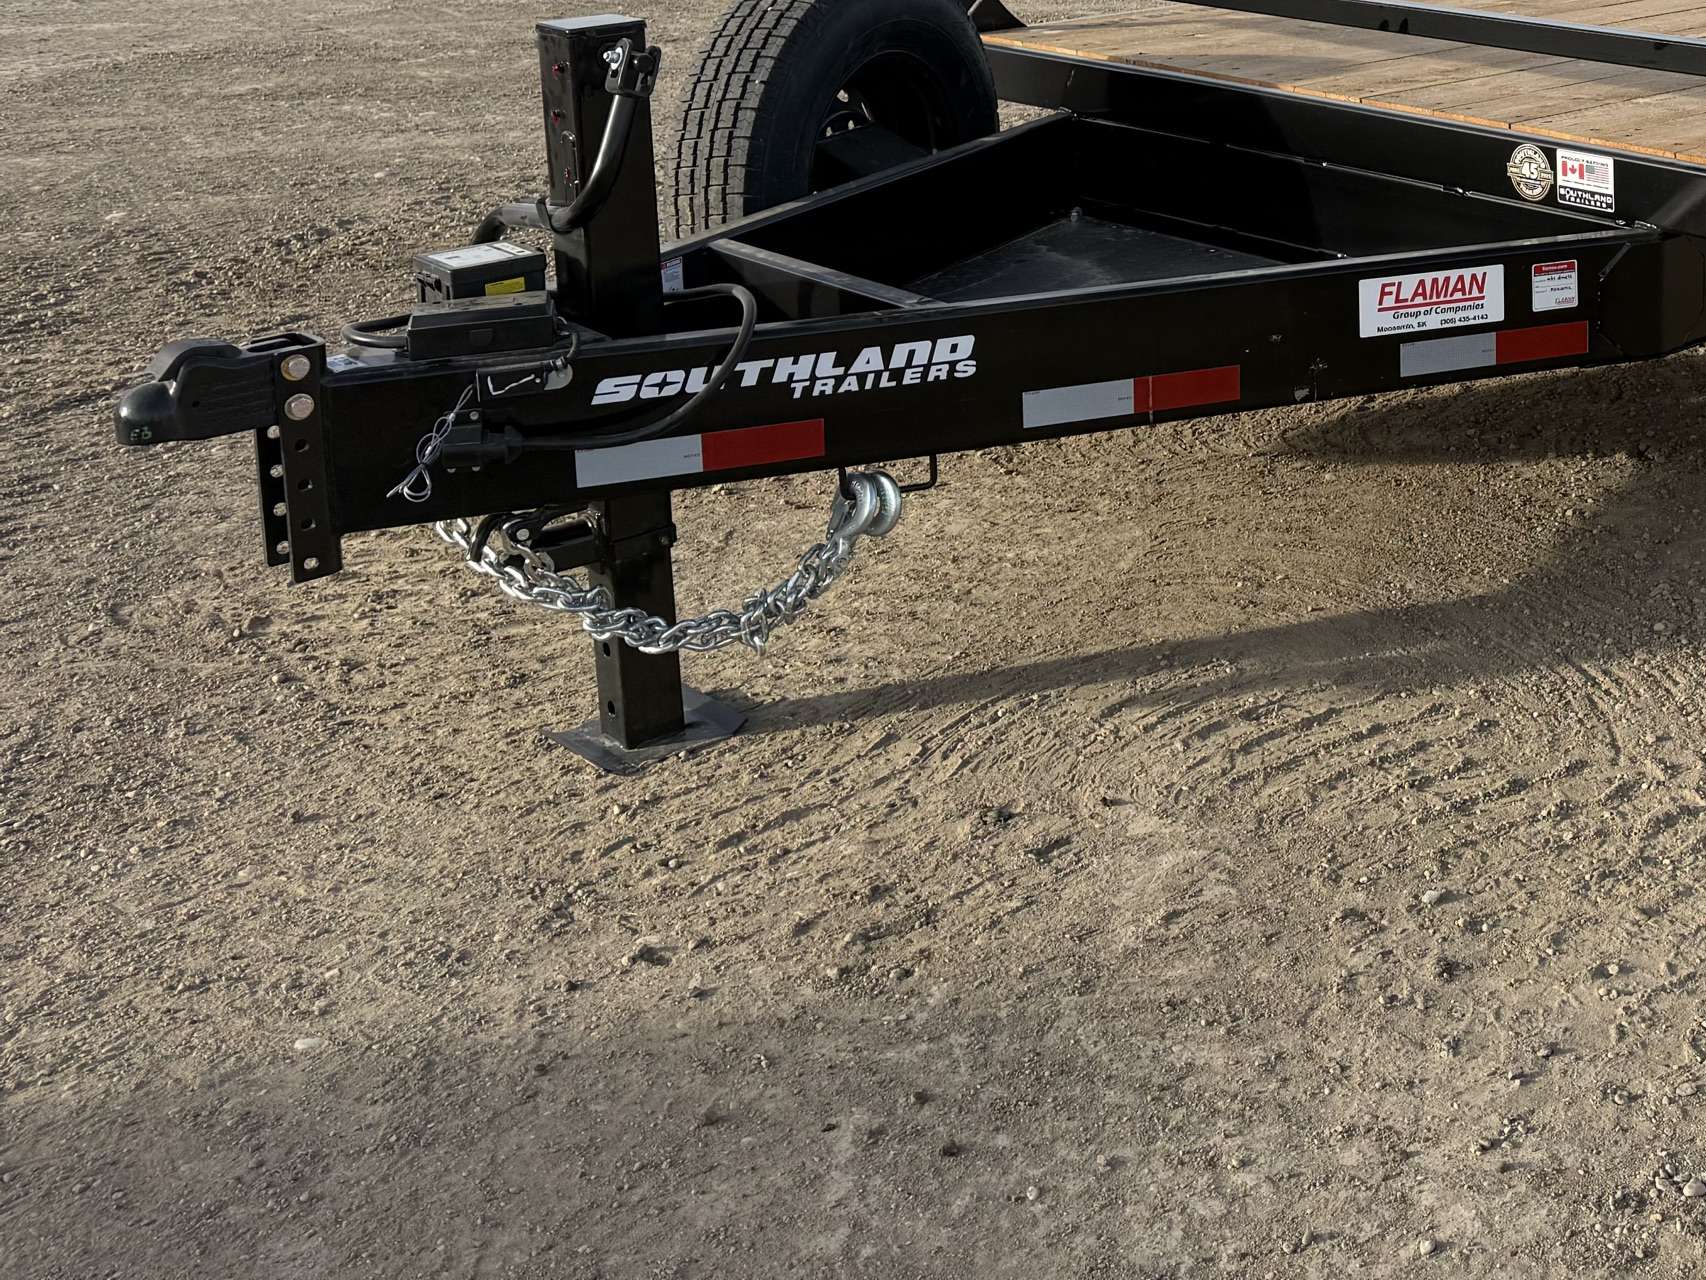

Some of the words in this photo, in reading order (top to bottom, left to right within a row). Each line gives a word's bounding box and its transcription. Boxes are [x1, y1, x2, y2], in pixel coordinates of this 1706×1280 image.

[1521, 161, 1539, 180] 45
[1559, 187, 1613, 204] SOUTHLAND
[1565, 195, 1607, 209] TRAILERS
[1378, 271, 1487, 306] FLAMAN
[1392, 309, 1421, 320] Group
[1423, 307, 1434, 317] of
[1434, 301, 1485, 316] Companies
[591, 334, 976, 406] SOUTHLAND
[790, 360, 977, 400] TRAILERS
